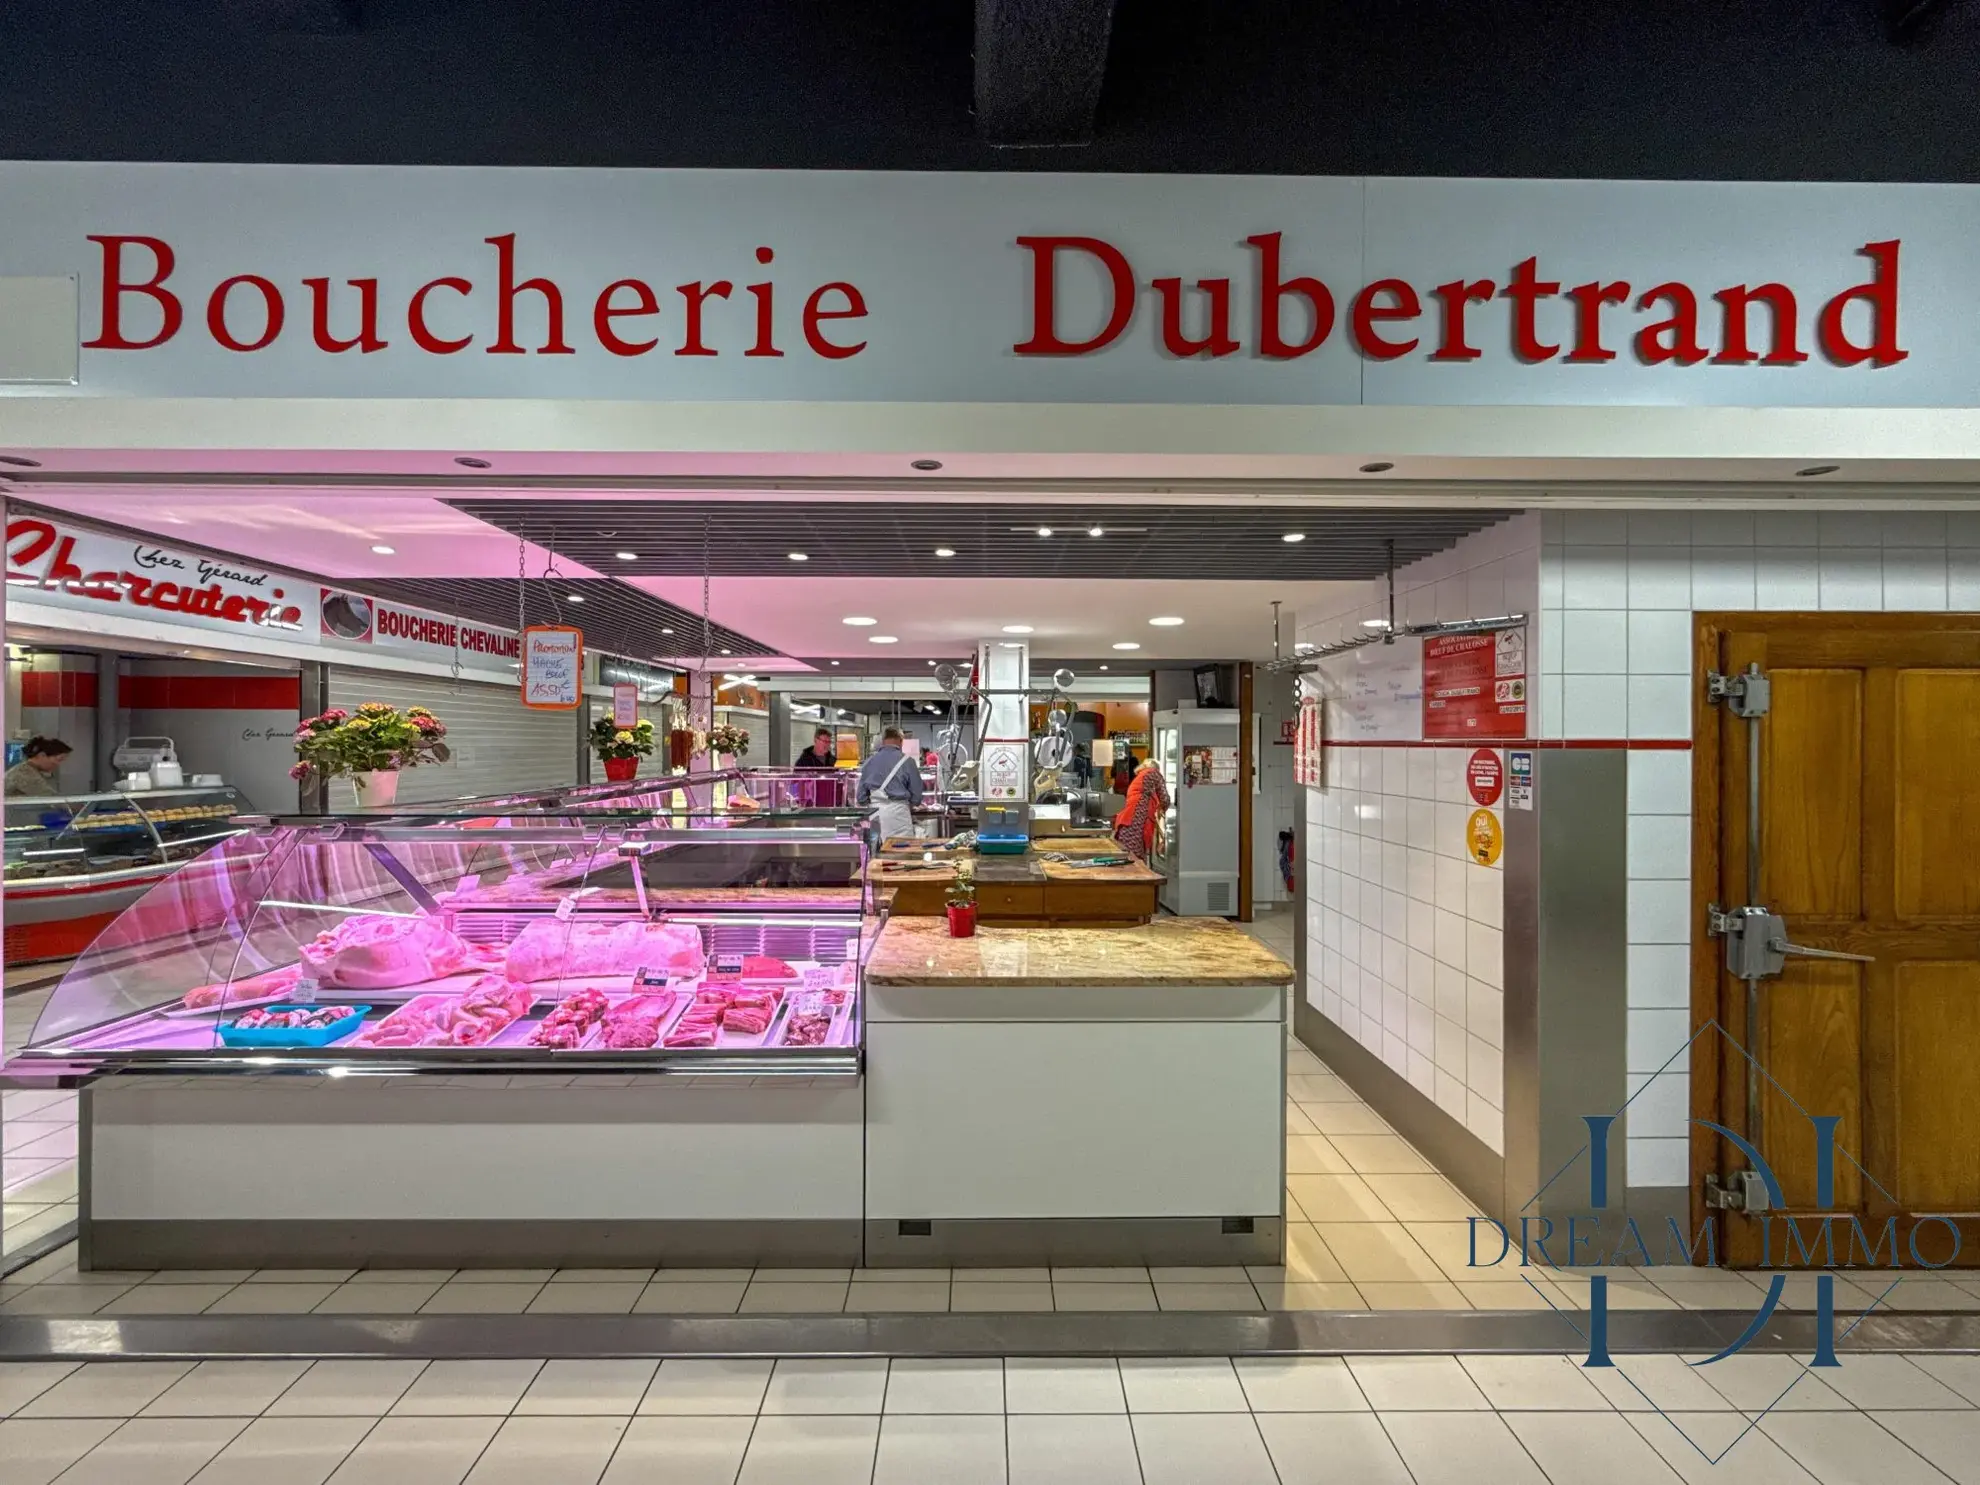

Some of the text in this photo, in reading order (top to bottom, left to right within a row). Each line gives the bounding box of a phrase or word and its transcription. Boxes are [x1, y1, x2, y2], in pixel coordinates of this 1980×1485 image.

[82, 231, 1909, 368] Boucherie Dubertrand
[6, 519, 303, 631] Charcuterie
[133, 545, 269, 587] Chez Gérard
[377, 608, 521, 659] BOUCHERIE CHEVALINE
